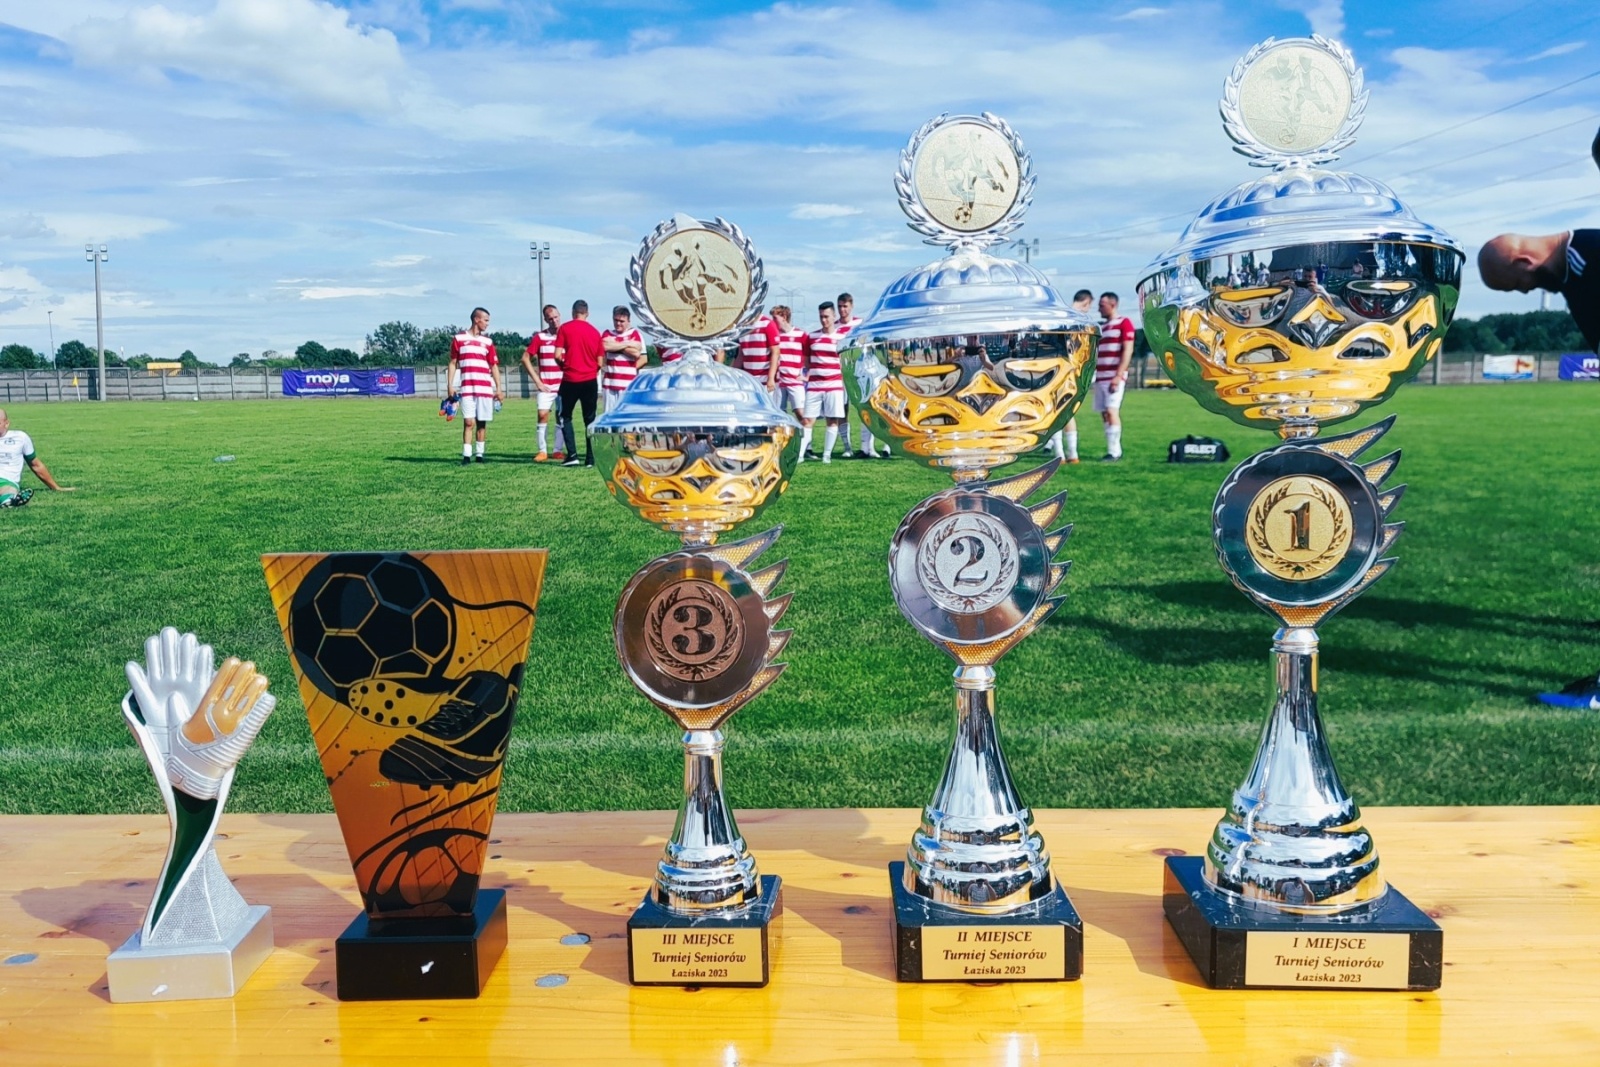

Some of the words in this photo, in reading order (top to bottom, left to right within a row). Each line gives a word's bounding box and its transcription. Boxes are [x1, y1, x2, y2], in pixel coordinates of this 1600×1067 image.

[305, 372, 350, 387] moya
[1283, 500, 1319, 552] 1
[950, 535, 988, 588] 2
[671, 604, 717, 656] 3
[662, 934, 676, 945] III
[682, 933, 735, 947] MIEJSCE
[957, 931, 968, 942] II
[974, 931, 1033, 945] MIEJSCE
[1292, 937, 1299, 948] I
[1305, 937, 1367, 951] MIEJSCE
[652, 952, 691, 966] Turniej
[694, 951, 746, 963] Seniorów
[942, 949, 986, 963] Turniej
[989, 948, 1047, 960] Seniorów
[1274, 954, 1320, 970] Turniej
[1322, 955, 1384, 969] Seniorów
[671, 968, 706, 978] Łaziska
[708, 968, 728, 978] 2023
[963, 965, 1001, 975] Łaziska
[1004, 965, 1026, 975] 2023
[1295, 972, 1336, 983] Łaziska
[1338, 973, 1362, 983] 2023
